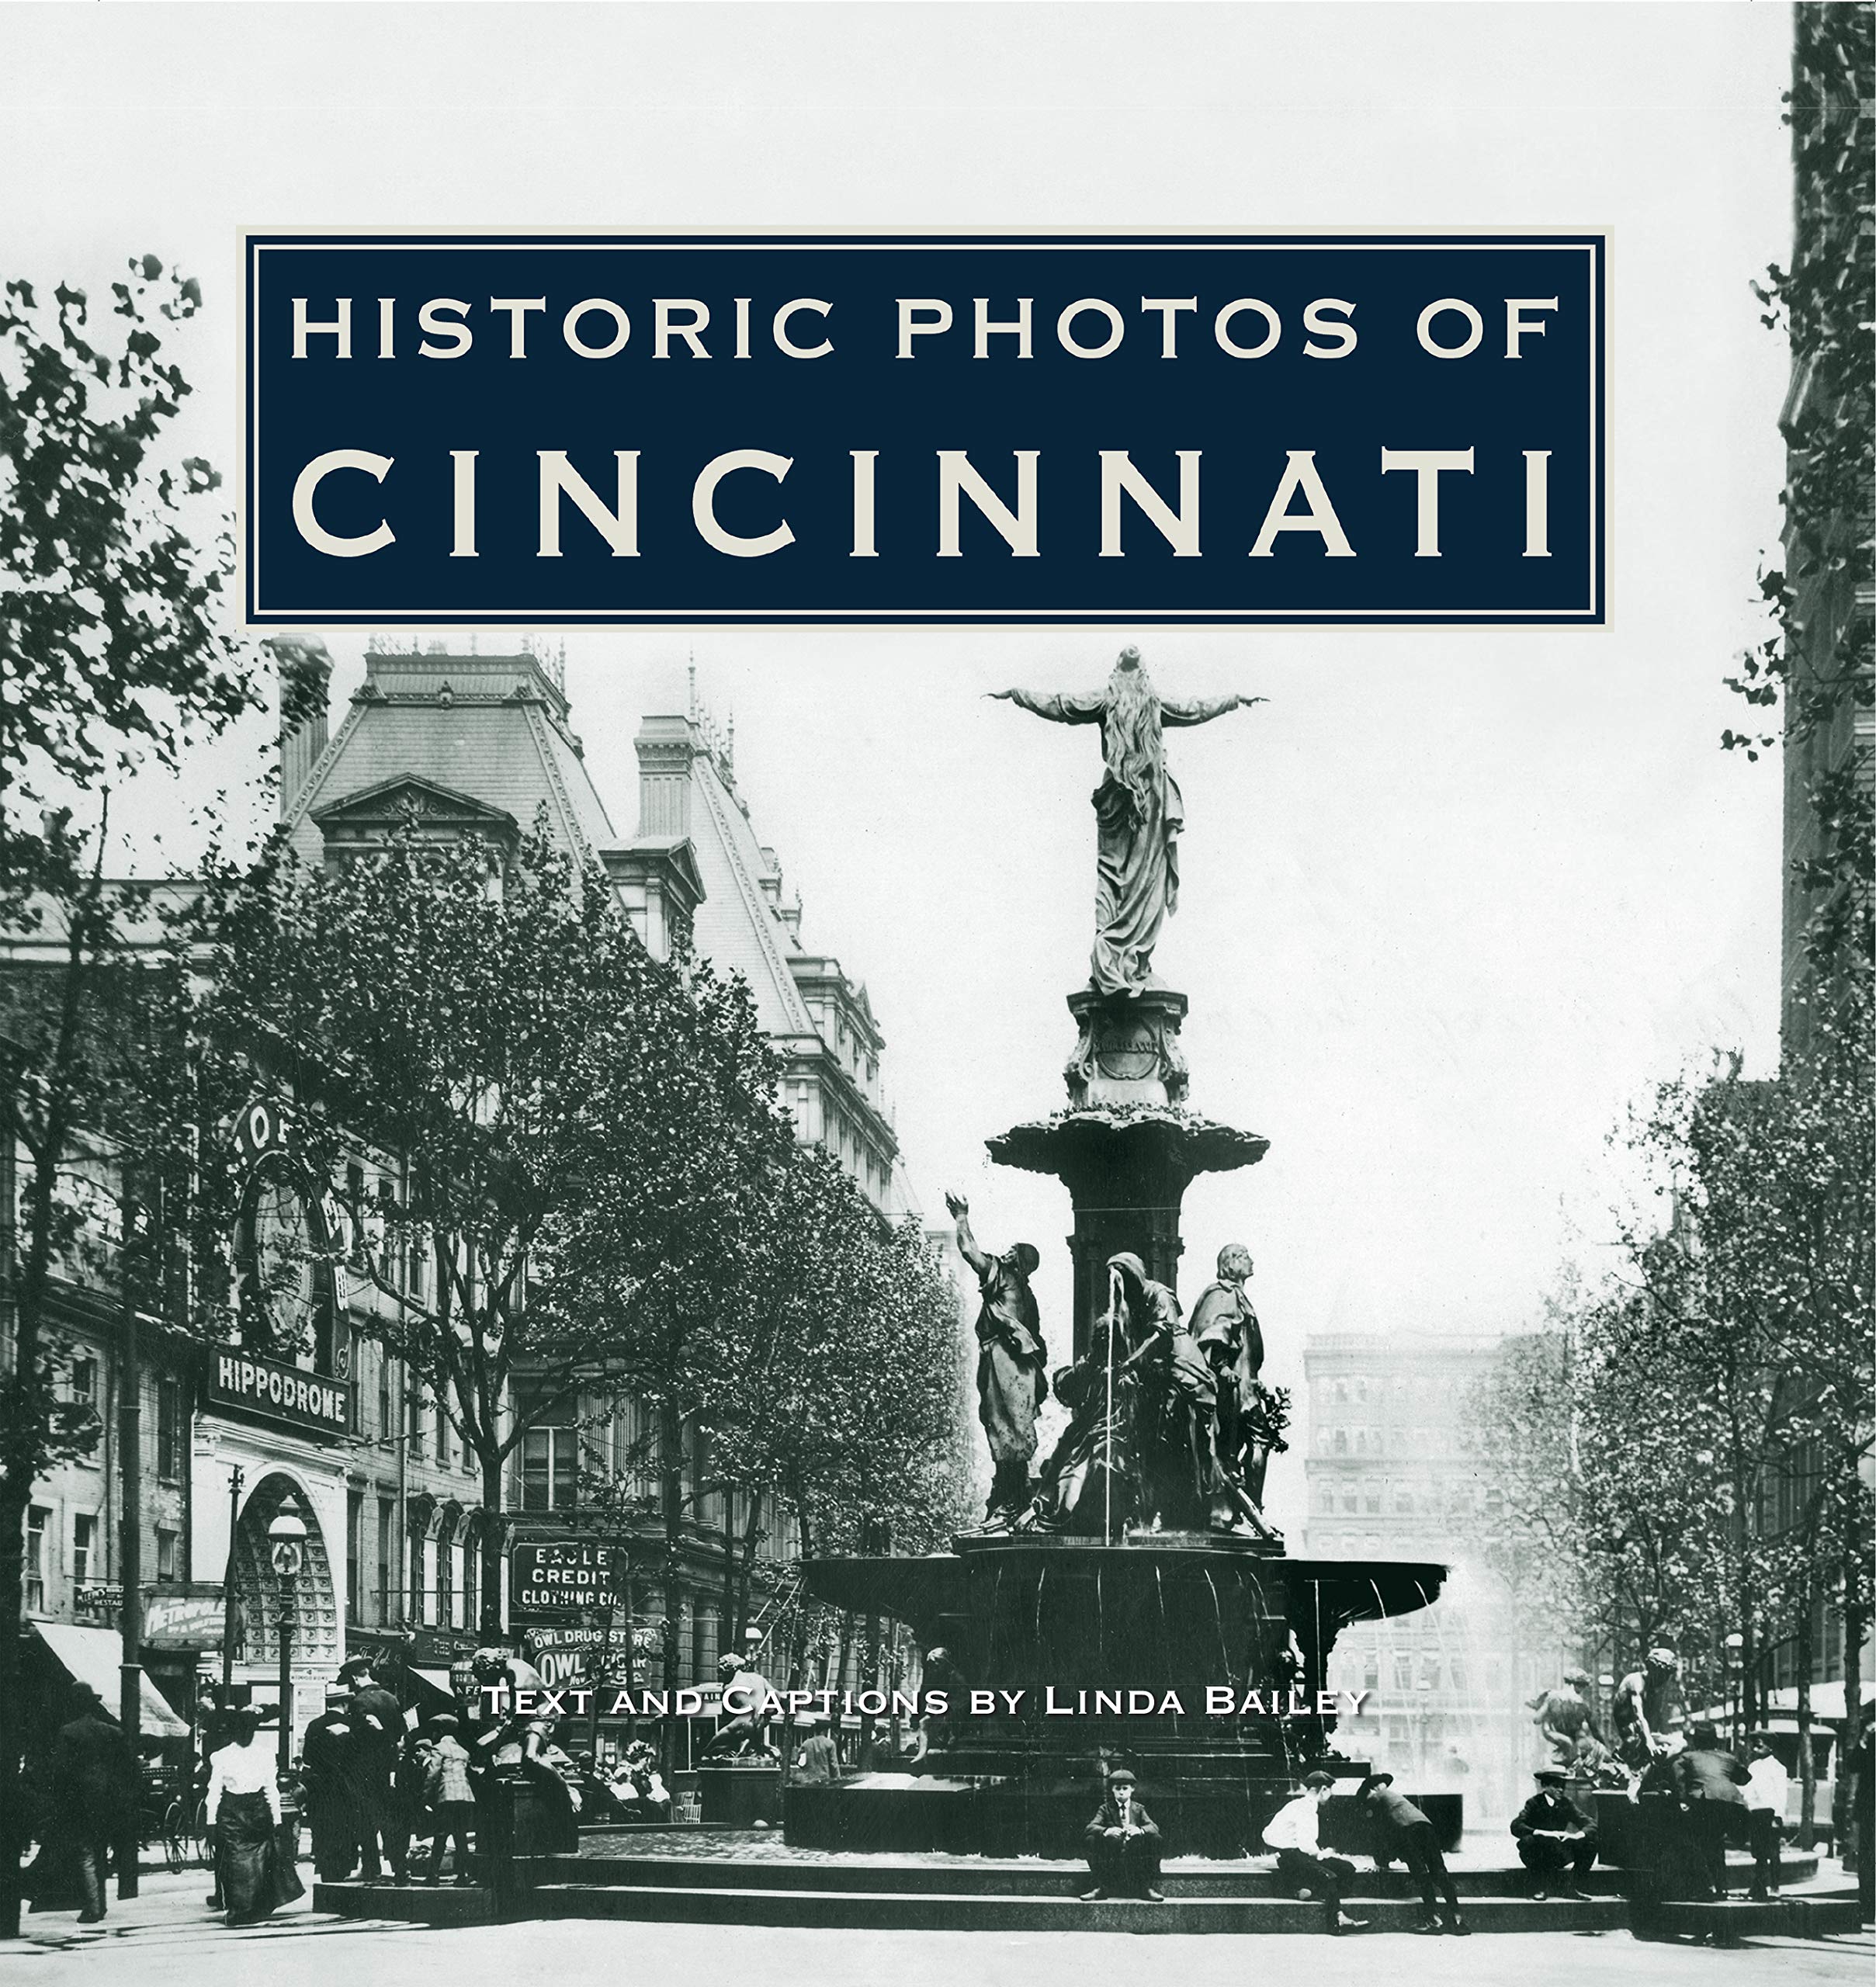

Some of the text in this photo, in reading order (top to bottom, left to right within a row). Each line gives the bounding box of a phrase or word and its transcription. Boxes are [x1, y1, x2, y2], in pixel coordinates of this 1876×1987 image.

[219, 1356, 346, 1423] HIPPODROME
[532, 1569, 611, 1585] CREDIT
[522, 1590, 595, 1605] CLOTHING
[534, 1629, 653, 1649] OWL DRUG STRE
[541, 1652, 647, 1688] OWL CIGR
[456, 1685, 480, 1696] AFE
